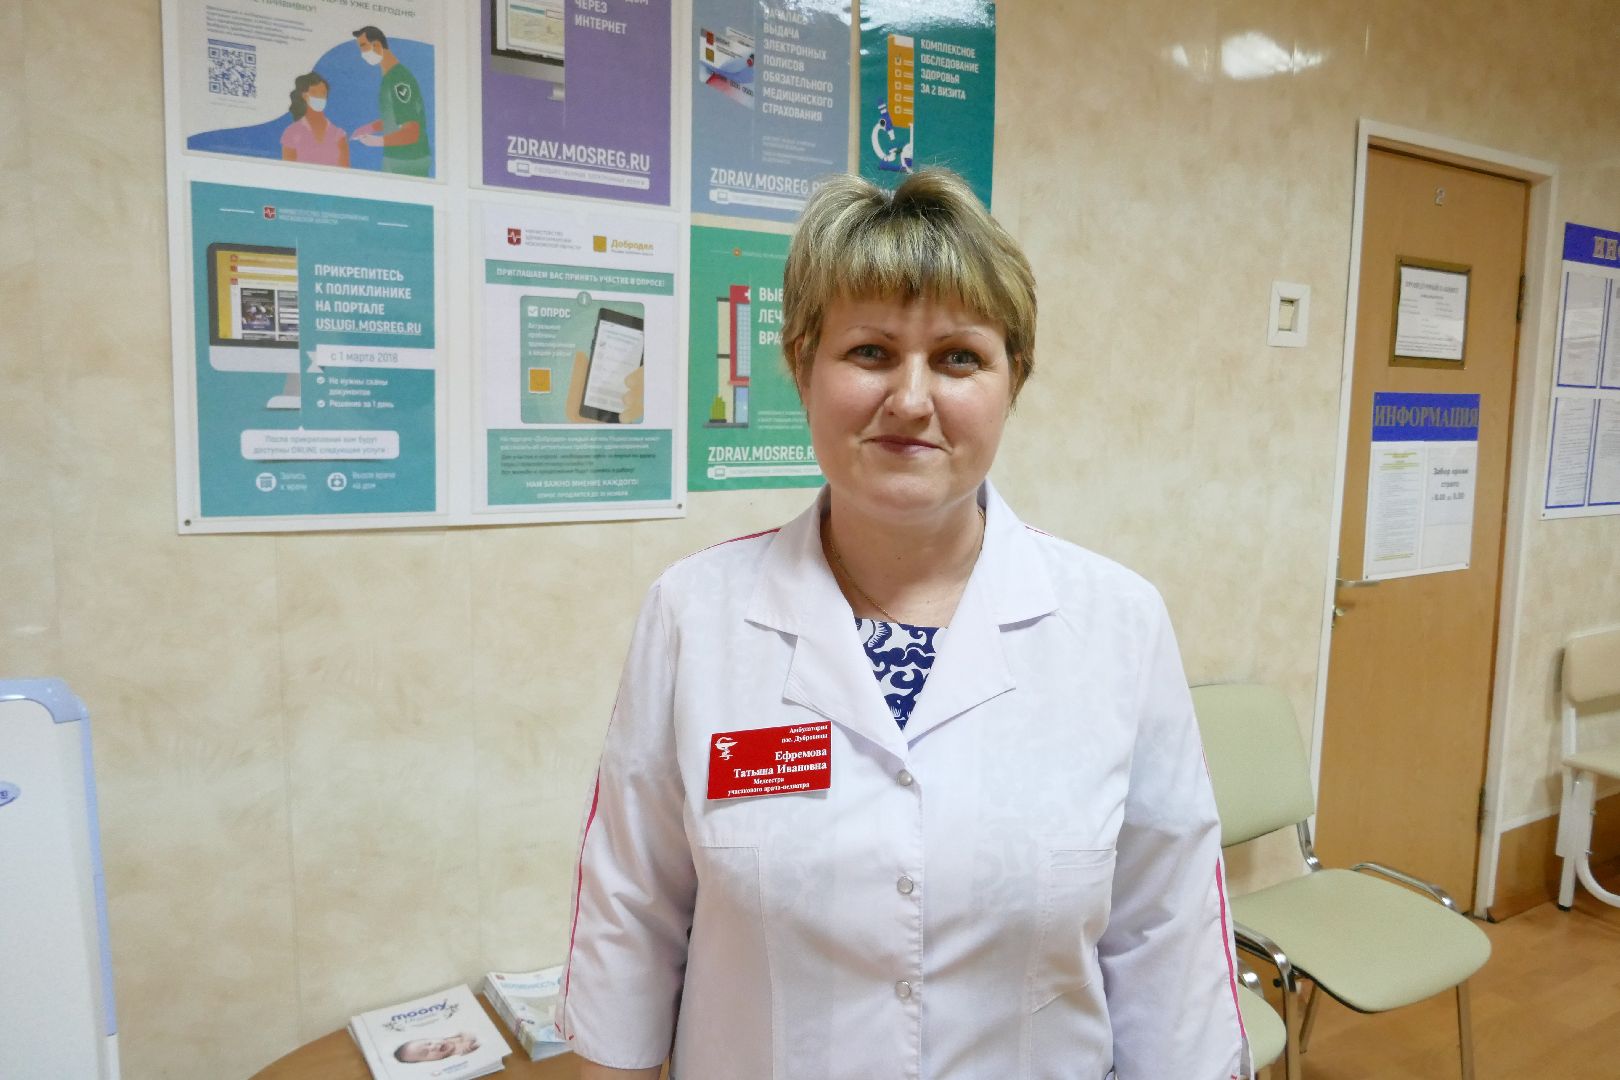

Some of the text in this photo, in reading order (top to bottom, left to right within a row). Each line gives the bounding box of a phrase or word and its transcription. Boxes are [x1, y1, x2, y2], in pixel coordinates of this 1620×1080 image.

[575, 0, 608, 14] ЧЕРЕЗ
[575, 14, 627, 35] ИНТЕРНЕТ
[763, 22, 799, 39] ВЫДАЧА
[763, 39, 827, 60] ЭЛЕКТРОННЫХ
[920, 39, 976, 58] КОМПЛЕКСНОЕ
[763, 55, 805, 72] ПОЛИСОВ
[920, 54, 979, 74] ОБСЛЕДОВАНИЕ
[763, 71, 833, 93] ОБЯЗАТЕЛЬНОГО
[920, 68, 960, 84] ЗДОРОВЬЯ
[763, 87, 833, 108] МЕДИЦИНСКОГО
[920, 83, 966, 100] ЗА 2 ВИЗИТА
[762, 103, 823, 122] СТРАХОВАНИЯ
[507, 136, 650, 172] ZDRAV.MOSREG.RU
[1434, 187, 1445, 206] 2
[314, 264, 404, 281] ПРИКРЕПИТЕСЬ
[549, 271, 564, 280] ВАС
[315, 282, 412, 300] К ПОЛИКЛИНИКЕ
[315, 300, 385, 315] НА ПОРТАЛЕ
[540, 307, 571, 318] ОПРОС
[316, 318, 421, 334] USLUGI.MOSREG.RU
[346, 353, 375, 363] марта
[1374, 405, 1480, 428] ИНФОРМАЦИЯ
[708, 445, 815, 461] ZDRAV.MOSREG.R
[775, 748, 827, 762] Ефремова
[734, 761, 827, 778] Татьяна Ивановна
[391, 999, 448, 1022] moony
